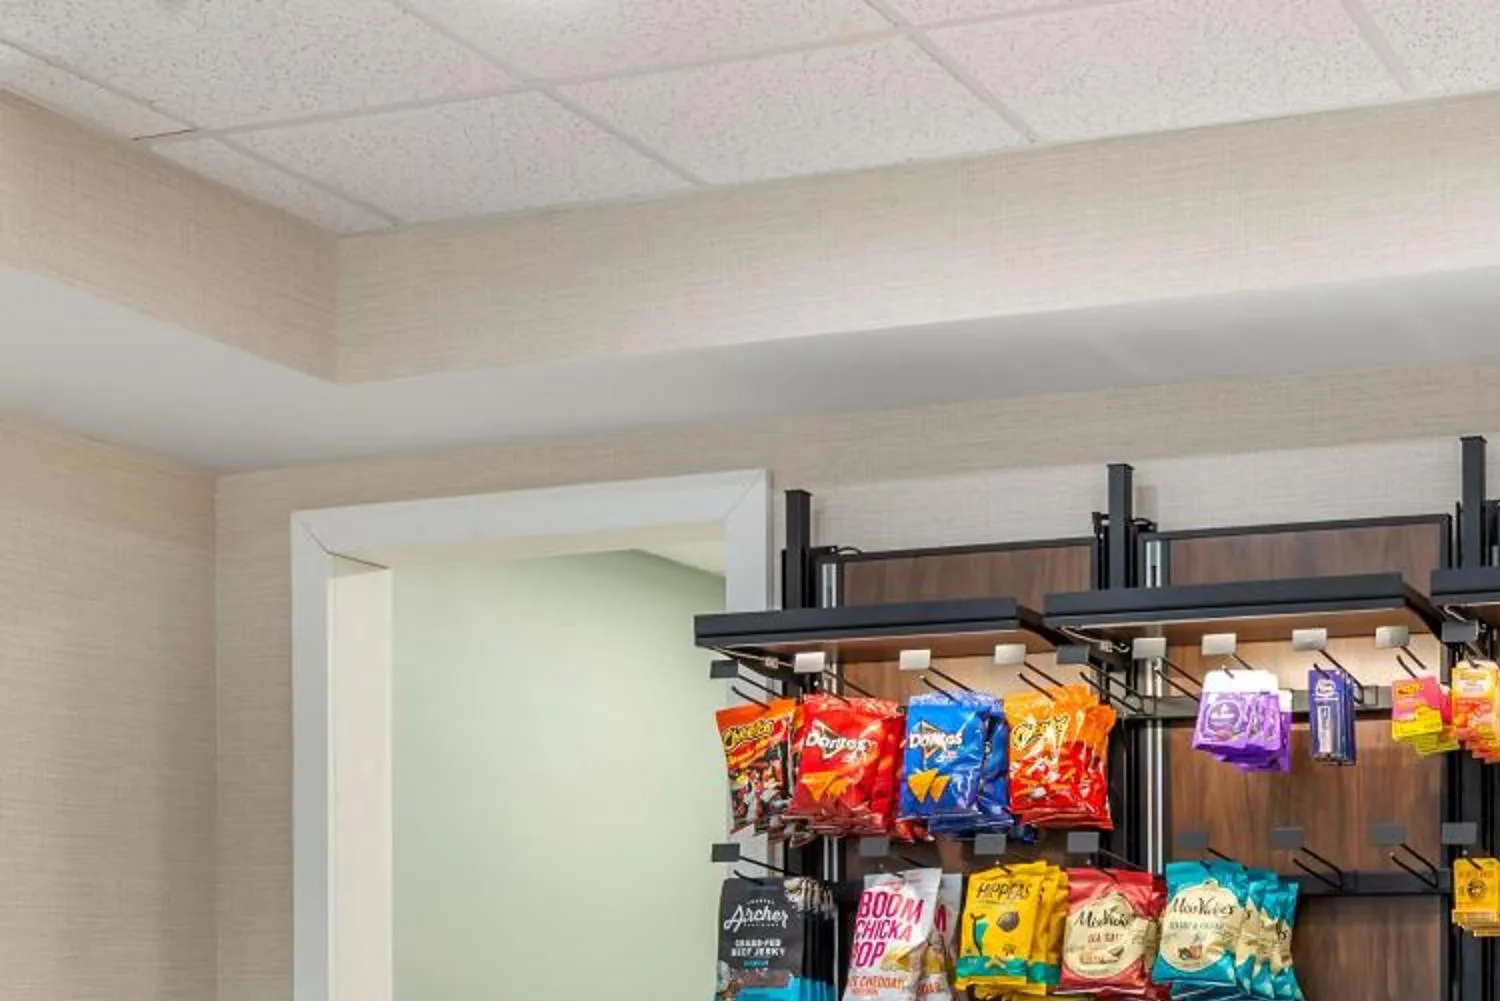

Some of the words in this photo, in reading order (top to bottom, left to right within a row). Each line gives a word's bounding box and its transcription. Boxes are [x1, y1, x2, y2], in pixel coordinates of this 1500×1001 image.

[805, 731, 872, 751] Doritos
[724, 904, 789, 933] Archer
[859, 891, 925, 924] BOOM
